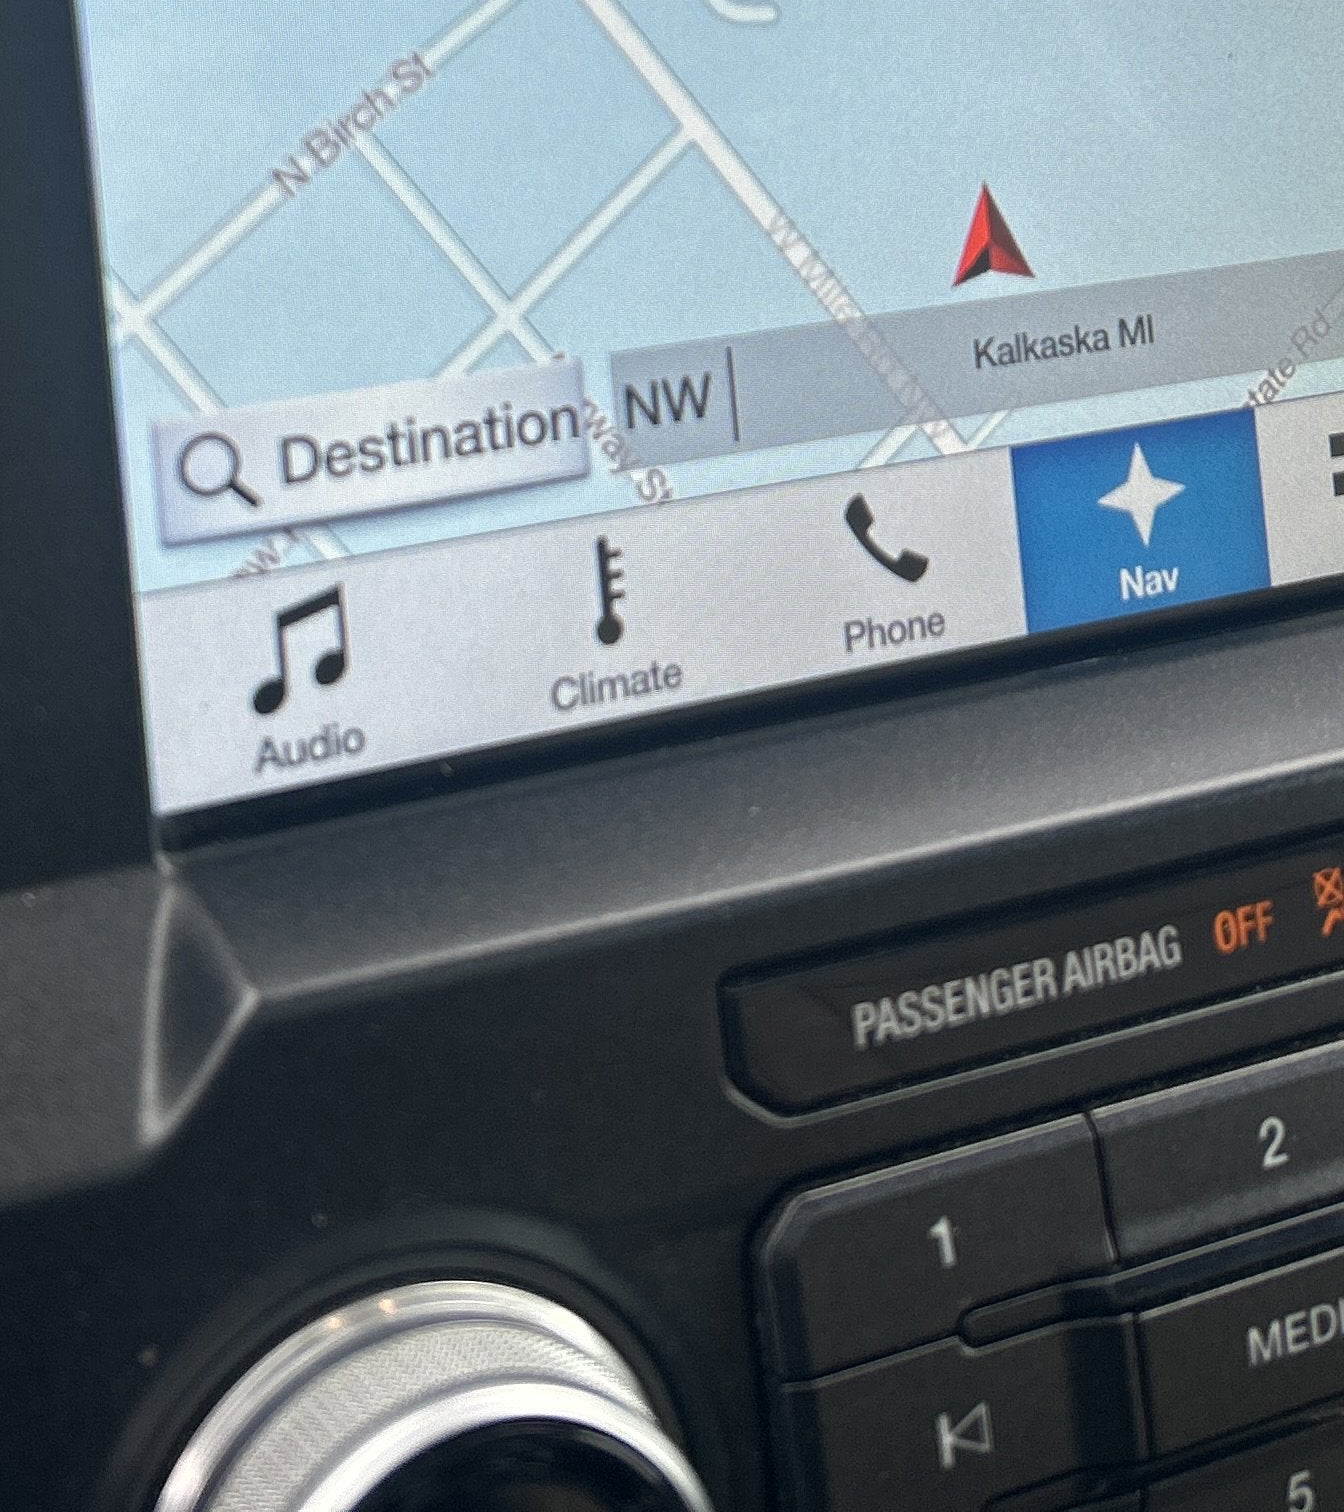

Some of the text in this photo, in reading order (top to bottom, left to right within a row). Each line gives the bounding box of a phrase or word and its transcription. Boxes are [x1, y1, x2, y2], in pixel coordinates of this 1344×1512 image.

[271, 52, 434, 197] N Birch St
[973, 314, 1155, 370] Kalkaska MI
[624, 370, 711, 429] NW
[280, 401, 581, 485] Destination
[1120, 568, 1179, 600] Nav
[844, 611, 946, 652] Phone
[551, 659, 684, 712] Climate
[256, 723, 366, 774] Audio
[853, 961, 1056, 1049] PASSENGER
[1062, 925, 1183, 995] AIRBAG
[1212, 900, 1274, 954] OFF
[1259, 1117, 1289, 1168] 2
[928, 1216, 958, 1267] 1
[1287, 1469, 1316, 1512] 5
